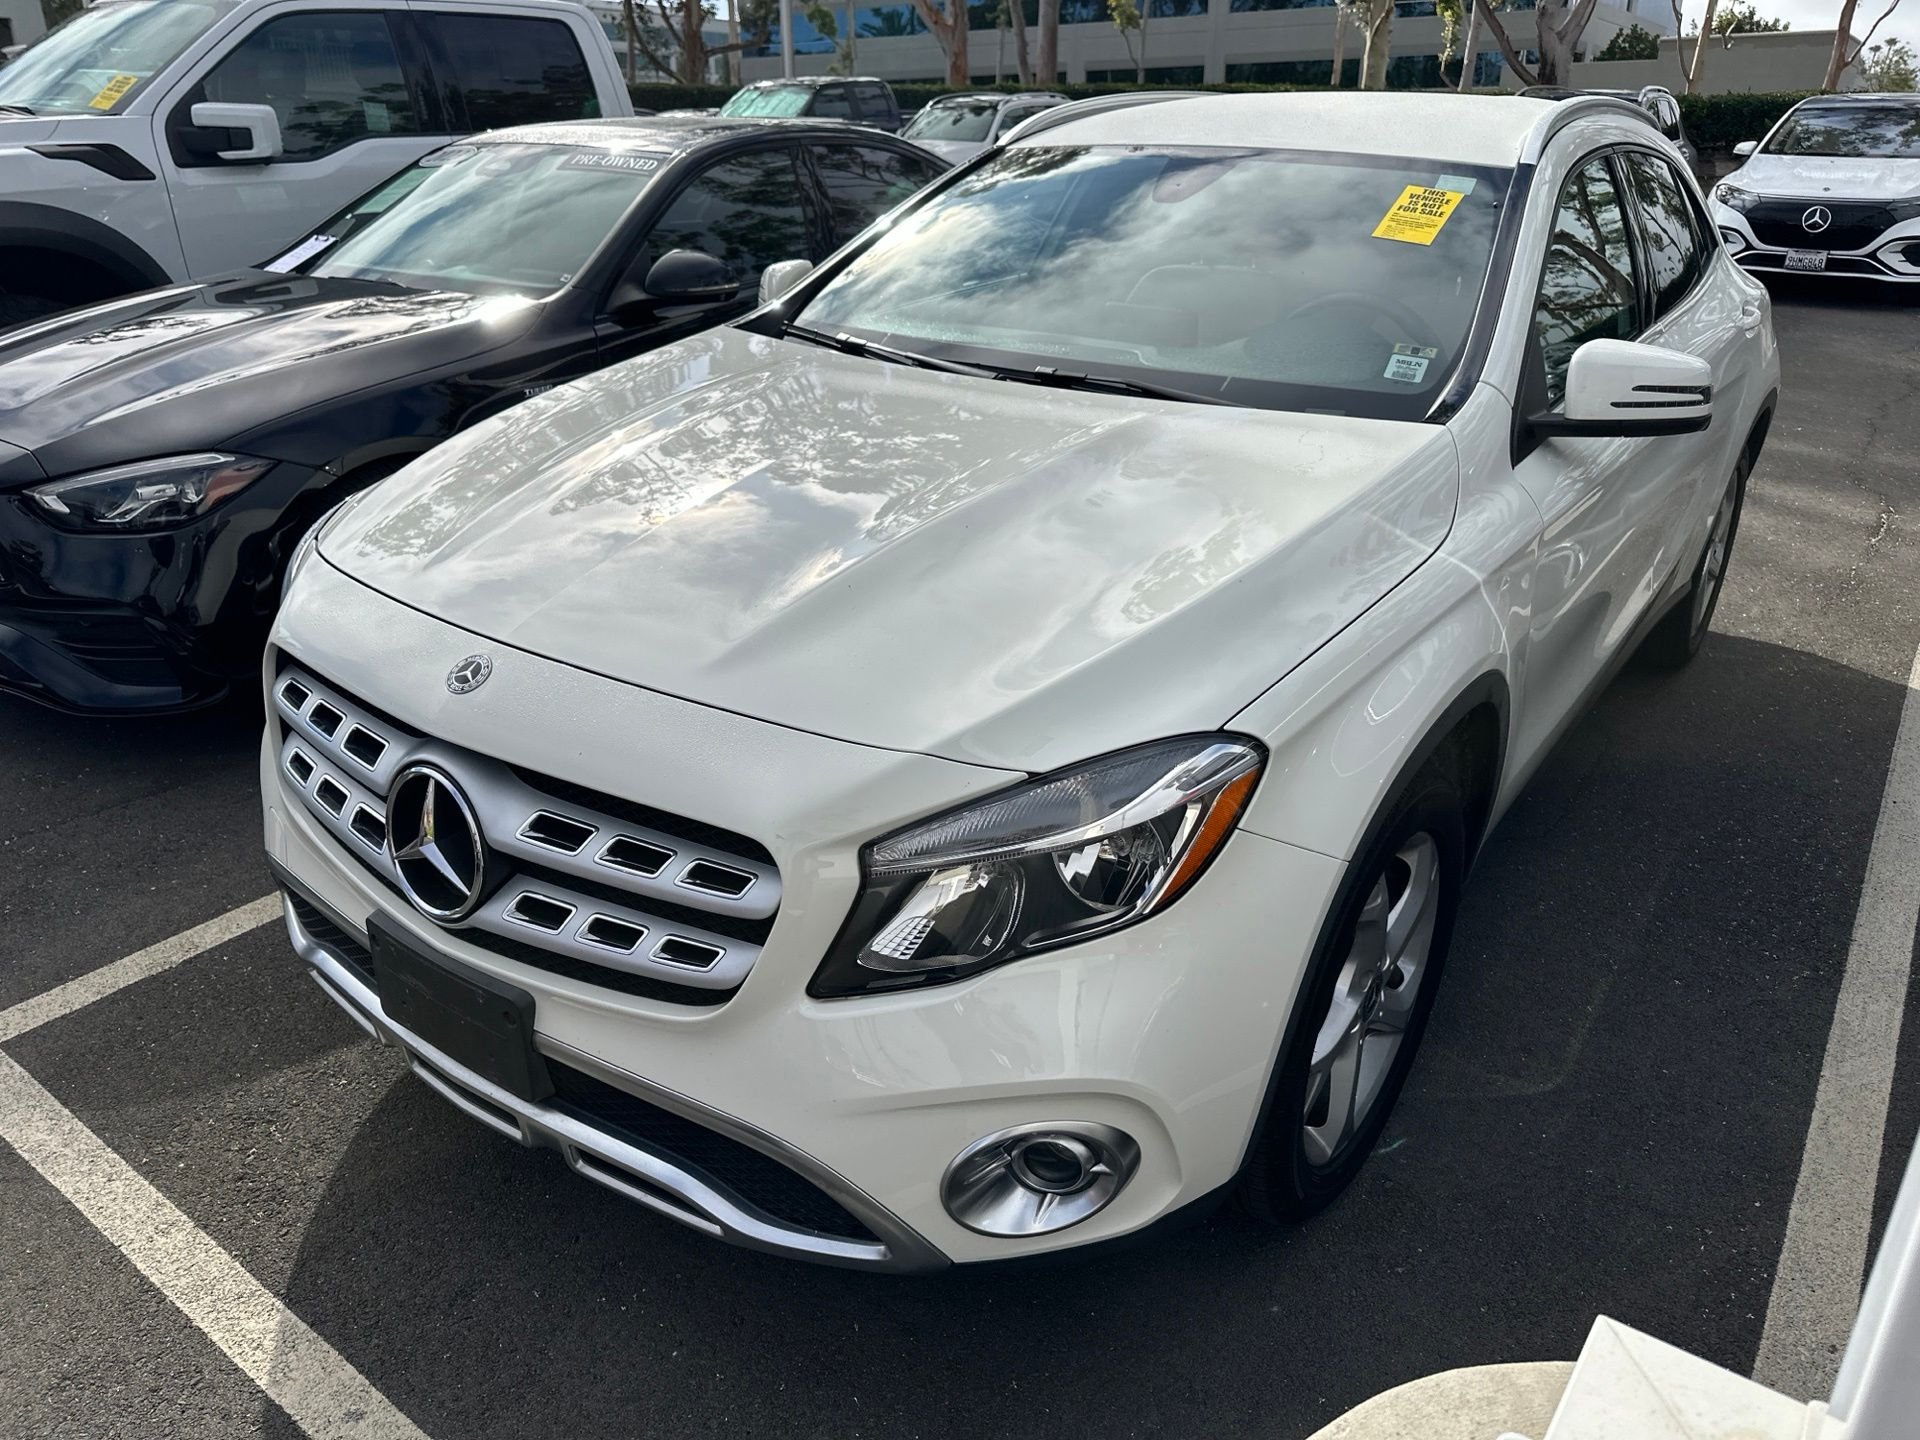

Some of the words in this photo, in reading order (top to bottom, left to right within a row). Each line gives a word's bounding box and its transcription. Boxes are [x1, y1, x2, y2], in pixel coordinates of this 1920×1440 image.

[571, 154, 658, 170] PRE-OWNED
[1408, 193, 1453, 205] VEHICLE
[1422, 188, 1448, 198] THIS
[1396, 204, 1417, 213] FOR
[1419, 208, 1446, 218] SALE
[1421, 201, 1445, 210] NOT
